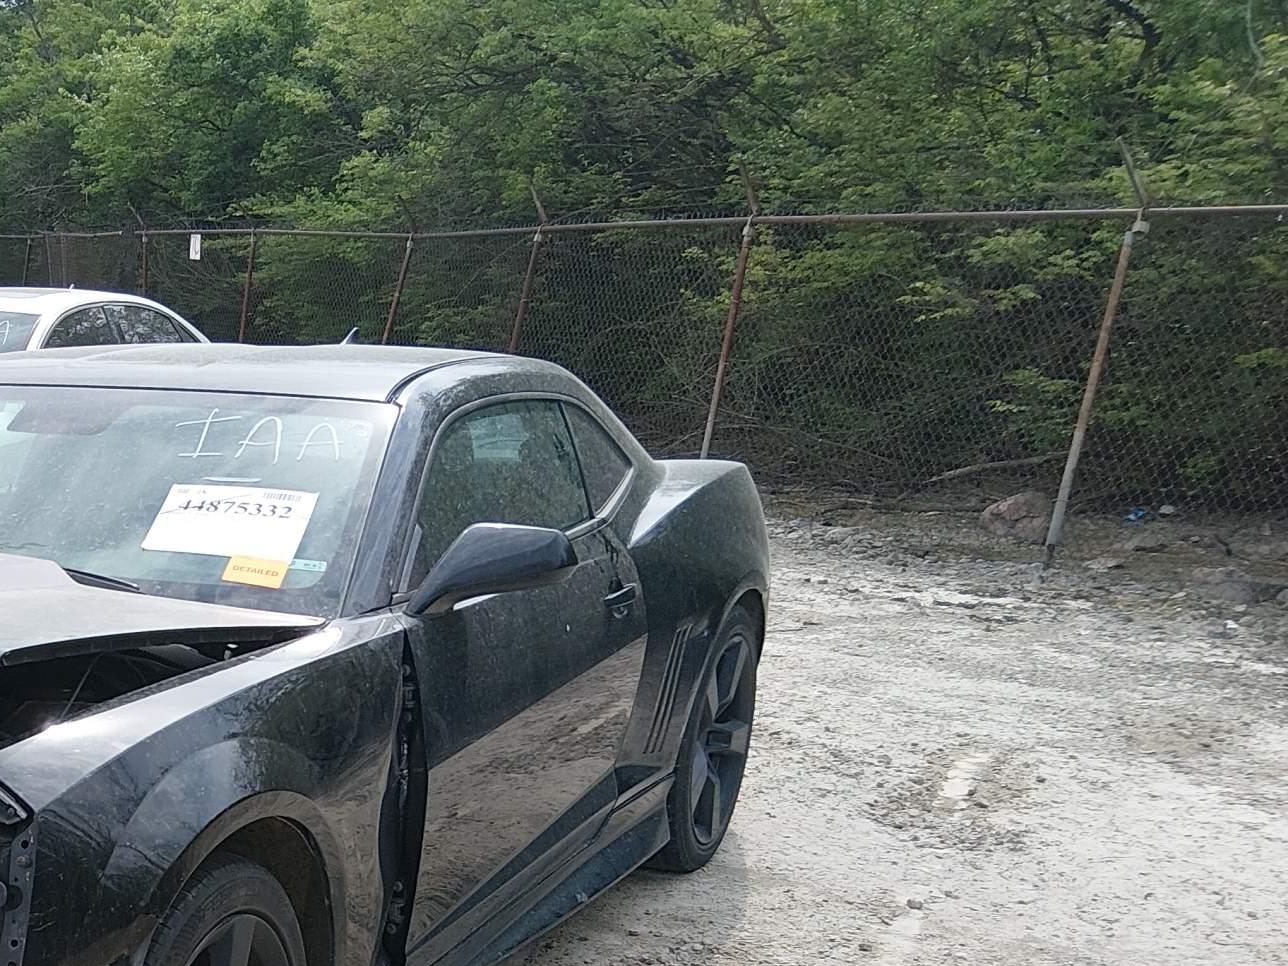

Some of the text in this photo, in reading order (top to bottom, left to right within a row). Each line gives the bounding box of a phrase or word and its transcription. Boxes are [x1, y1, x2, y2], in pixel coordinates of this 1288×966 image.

[175, 407, 344, 465] IAA
[178, 499, 293, 519] 44875332
[232, 565, 280, 577] DETAILED
